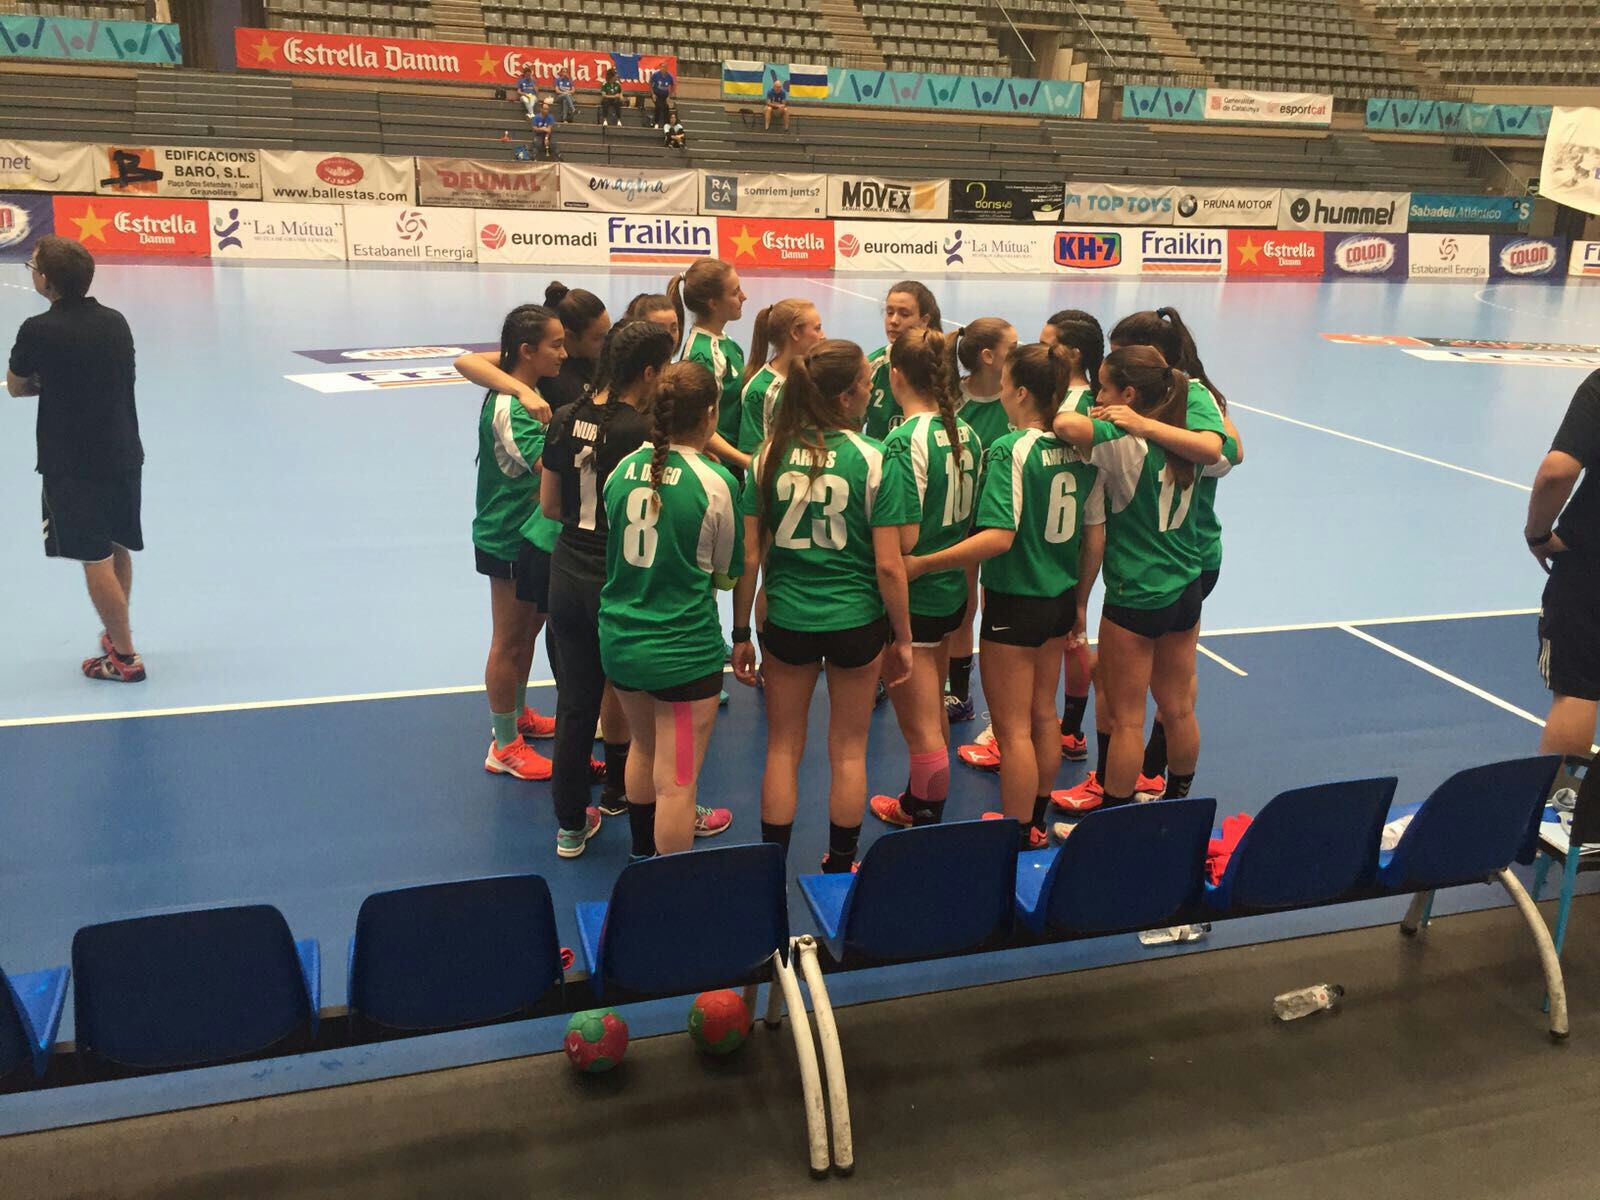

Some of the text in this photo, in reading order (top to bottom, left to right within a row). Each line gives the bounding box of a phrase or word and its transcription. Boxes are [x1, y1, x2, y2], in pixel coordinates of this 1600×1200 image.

[283, 37, 460, 73] Estrella Damm
[1280, 103, 1326, 116] esportcat
[165, 150, 256, 163] EDIFICACIONS
[175, 163, 250, 179] BARÓ, S.L.
[437, 169, 541, 192] DEUMAL
[190, 188, 238, 197] Granollers
[273, 187, 407, 202] www.ballestas.com
[744, 186, 820, 198] somriem junts?
[1087, 196, 1172, 213] TOP TOYS
[1203, 200, 1273, 210] PRUNA MOTOR
[1314, 198, 1395, 225] hummel
[1410, 204, 1456, 218] Sabadell
[114, 210, 197, 234] Estrella
[608, 216, 710, 245] Fraikin
[139, 235, 176, 245] Damm
[511, 232, 597, 247] euromadi
[762, 230, 825, 250] Estrella
[864, 240, 938, 255] euromadi
[1142, 231, 1222, 255] Fraikin
[353, 244, 473, 260] Estabanell Energia
[781, 249, 808, 259] Damm
[1059, 236, 1118, 260] KH-7
[1263, 240, 1315, 258] Estrella
[1278, 257, 1301, 266] Damm
[1411, 264, 1453, 274] Estabanell
[624, 462, 637, 480] A.
[942, 450, 974, 527] 16
[775, 471, 849, 551] 23
[1044, 471, 1077, 544] 6
[623, 487, 661, 568] 8
